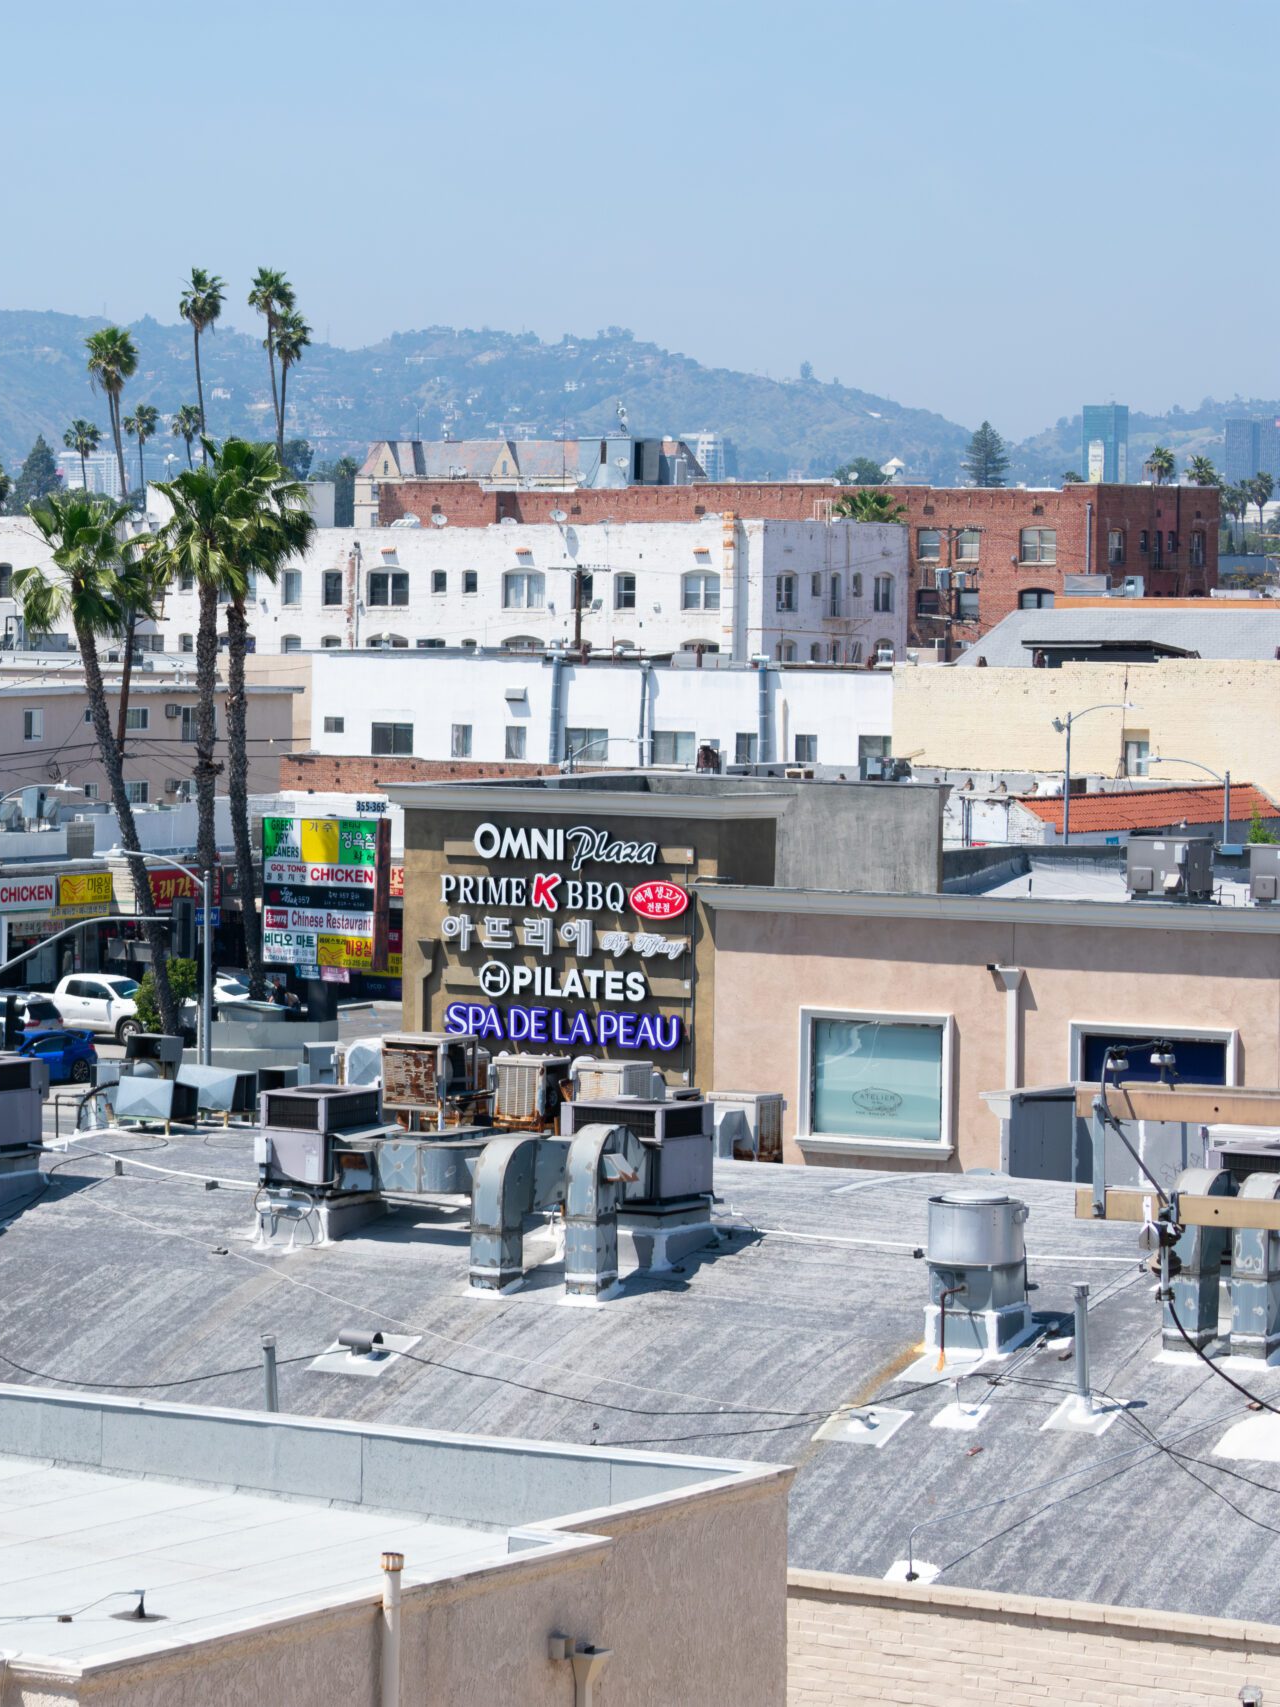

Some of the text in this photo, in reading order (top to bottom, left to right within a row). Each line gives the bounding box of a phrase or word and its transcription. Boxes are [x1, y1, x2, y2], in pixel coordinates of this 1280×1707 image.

[356, 802, 386, 812] 355-365
[272, 819, 294, 831] GREEN
[276, 832, 289, 843] DRY
[342, 832, 376, 850] 정육점
[474, 822, 657, 871] OMNI Plaza
[266, 846, 300, 857] CLEANERS
[287, 865, 307, 873] TONG
[310, 867, 374, 883] CHICKEN
[0, 884, 53, 903] CHICKEN
[87, 876, 110, 895] 미용실
[440, 874, 526, 906] PRIME
[531, 872, 562, 912] K
[566, 880, 625, 914] BBQ
[655, 886, 683, 906] 생고기
[647, 902, 670, 913] 전문점
[292, 910, 372, 931] Chinese Restaurant
[264, 932, 316, 948] 비디오 마트
[441, 914, 593, 957] 아뜨리에
[346, 940, 372, 957] 미용실
[601, 931, 686, 960] By Tiffany
[512, 965, 646, 1002] PILATES
[447, 1003, 679, 1048] SPA DE LA PEAU
